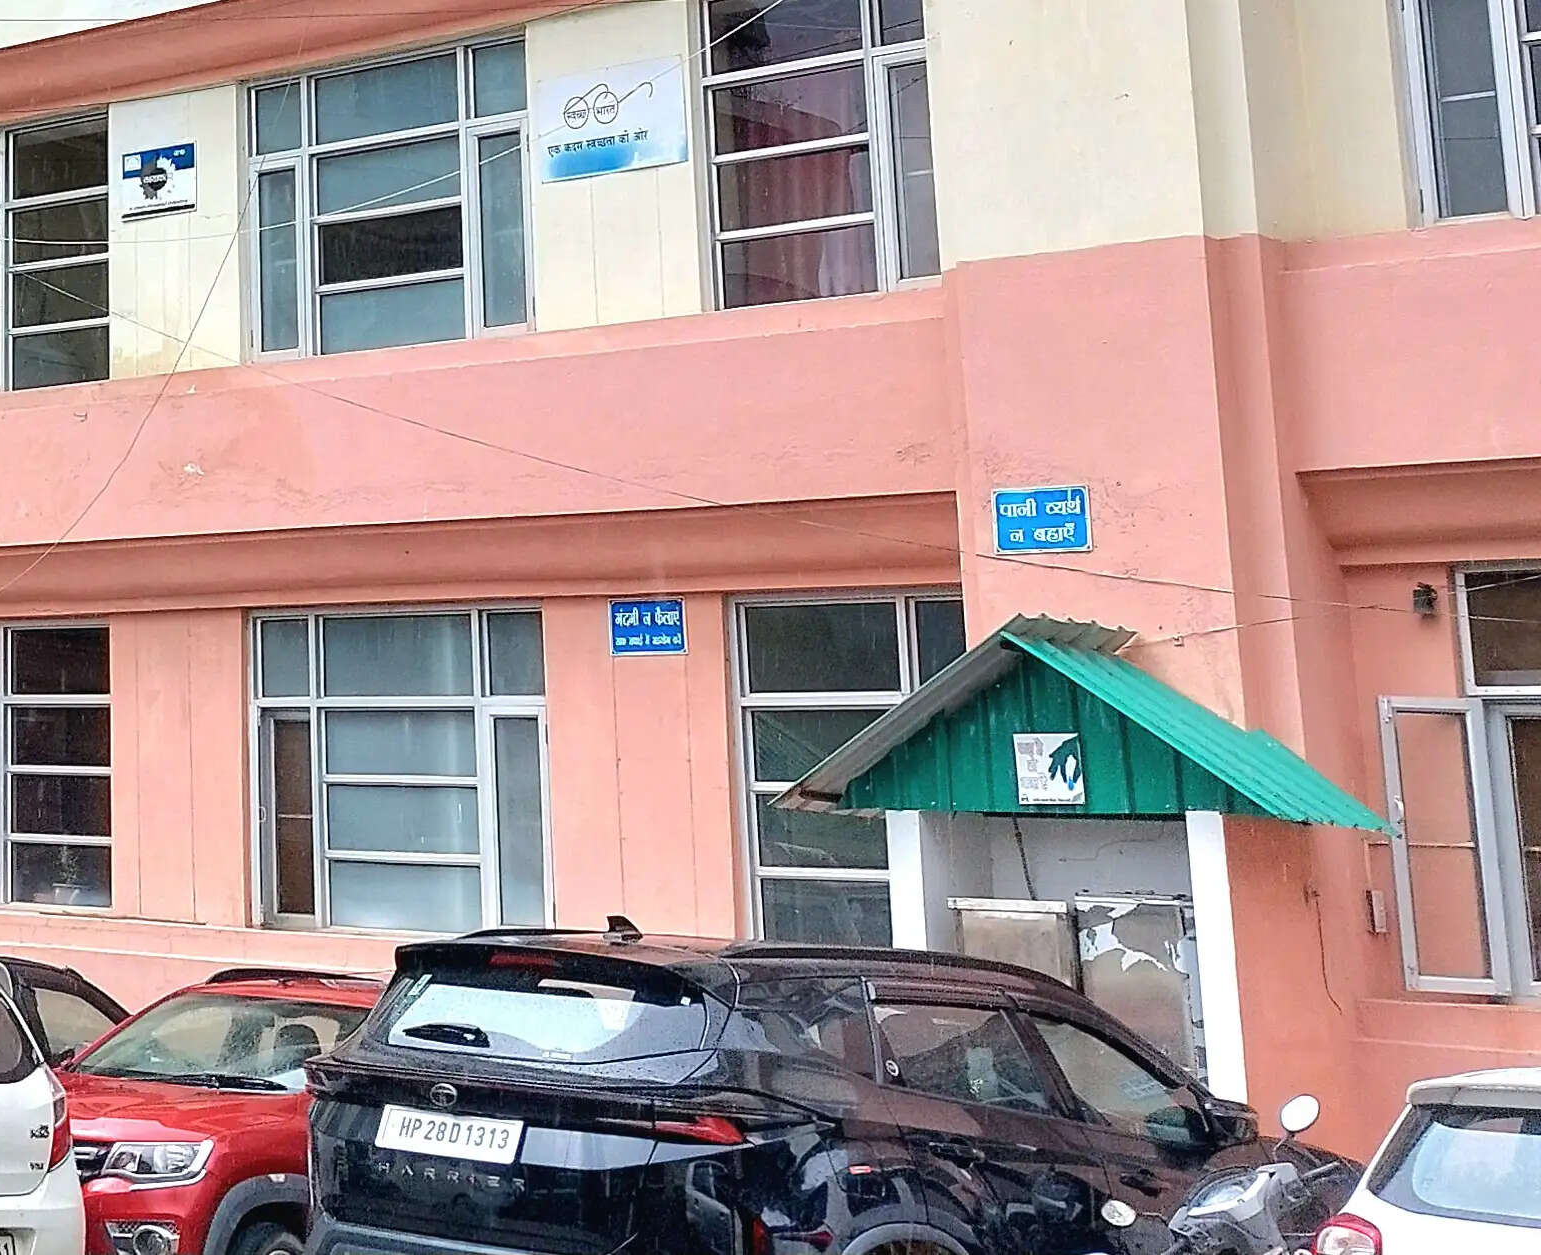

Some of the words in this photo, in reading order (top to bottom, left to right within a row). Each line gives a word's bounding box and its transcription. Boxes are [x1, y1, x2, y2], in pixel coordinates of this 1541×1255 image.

[596, 104, 615, 116] भारत
[999, 498, 1037, 517] पानी
[1009, 528, 1024, 542] न
[399, 1116, 510, 1149] HP28D1313
[378, 1162, 525, 1192] HARRIER
